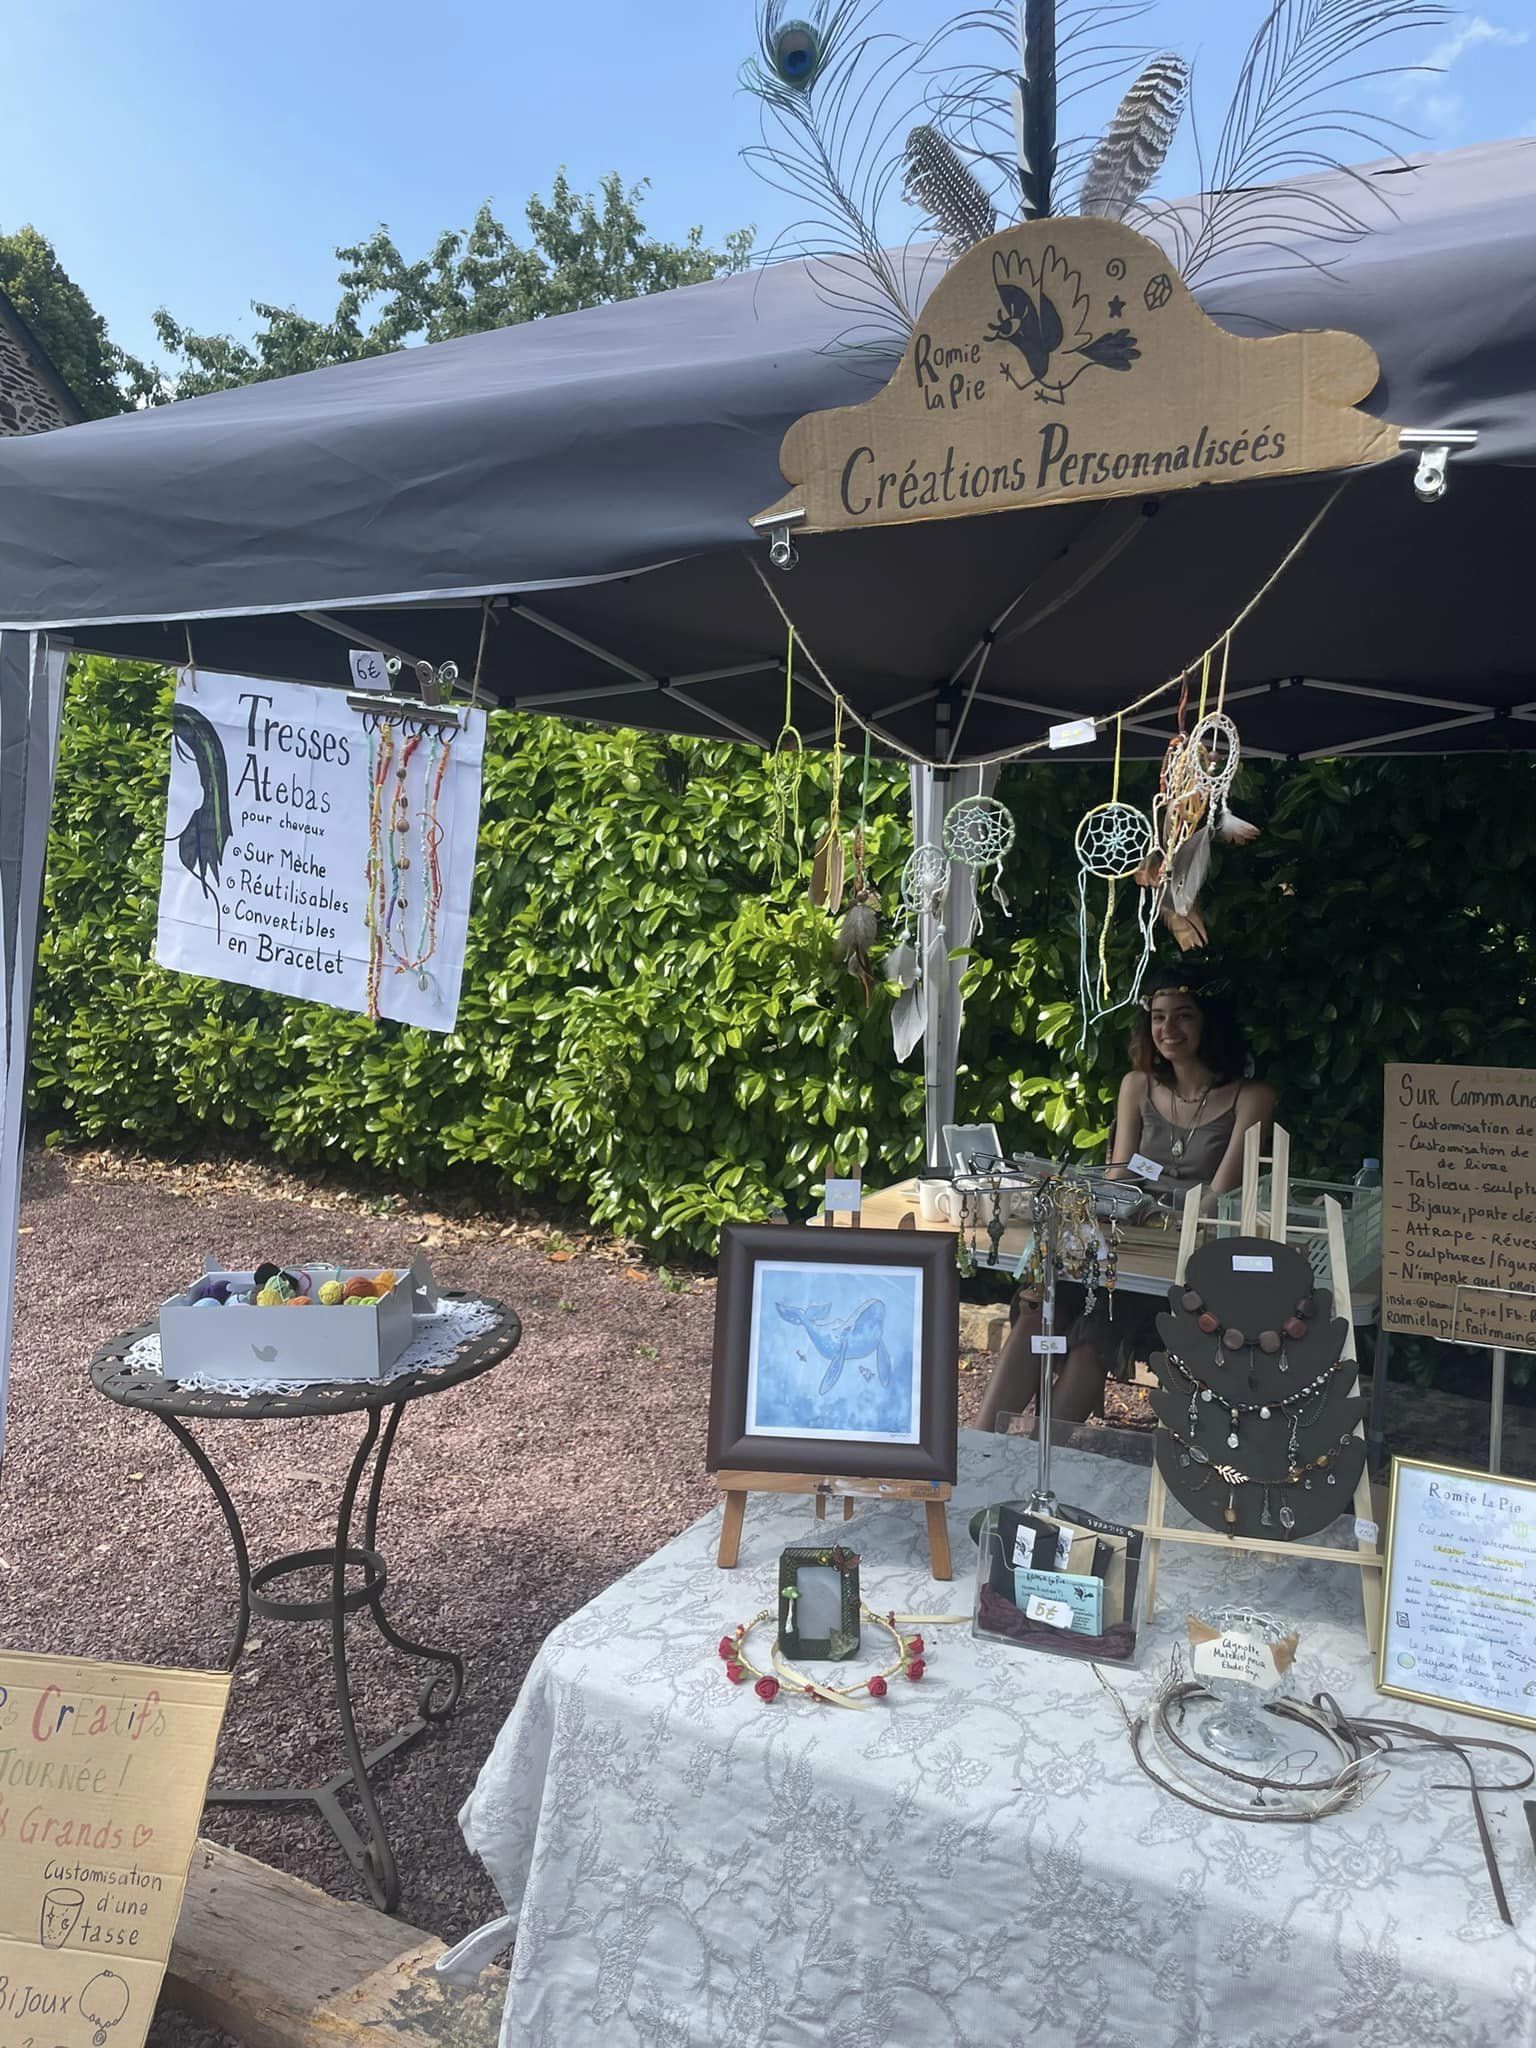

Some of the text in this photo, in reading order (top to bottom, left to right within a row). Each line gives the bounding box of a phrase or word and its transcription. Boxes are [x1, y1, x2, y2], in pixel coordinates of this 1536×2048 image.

[914, 334, 981, 388] Romie
[949, 377, 986, 409] Pie
[841, 446, 1026, 515] Créations
[356, 659, 381, 680] 6€
[239, 693, 350, 766] Tresses
[235, 754, 331, 813] Atebas
[241, 811, 325, 837] pour cheveux
[244, 844, 326, 879] Sur Mèche
[241, 870, 348, 913] Réutilisables
[228, 934, 343, 974] en Bracelet
[1412, 1113, 1534, 1137] Customisation de
[1438, 1158, 1456, 1170] de
[1510, 1145, 1529, 1158] de
[1429, 1482, 1477, 1505] Romie
[1499, 1497, 1521, 1513] Pie
[1035, 1602, 1058, 1621] 5€
[20, 1805, 123, 1849] Grands
[44, 1859, 163, 1891] Customisation
[97, 1892, 148, 1915] d'une
[81, 1917, 140, 1945] tasse
